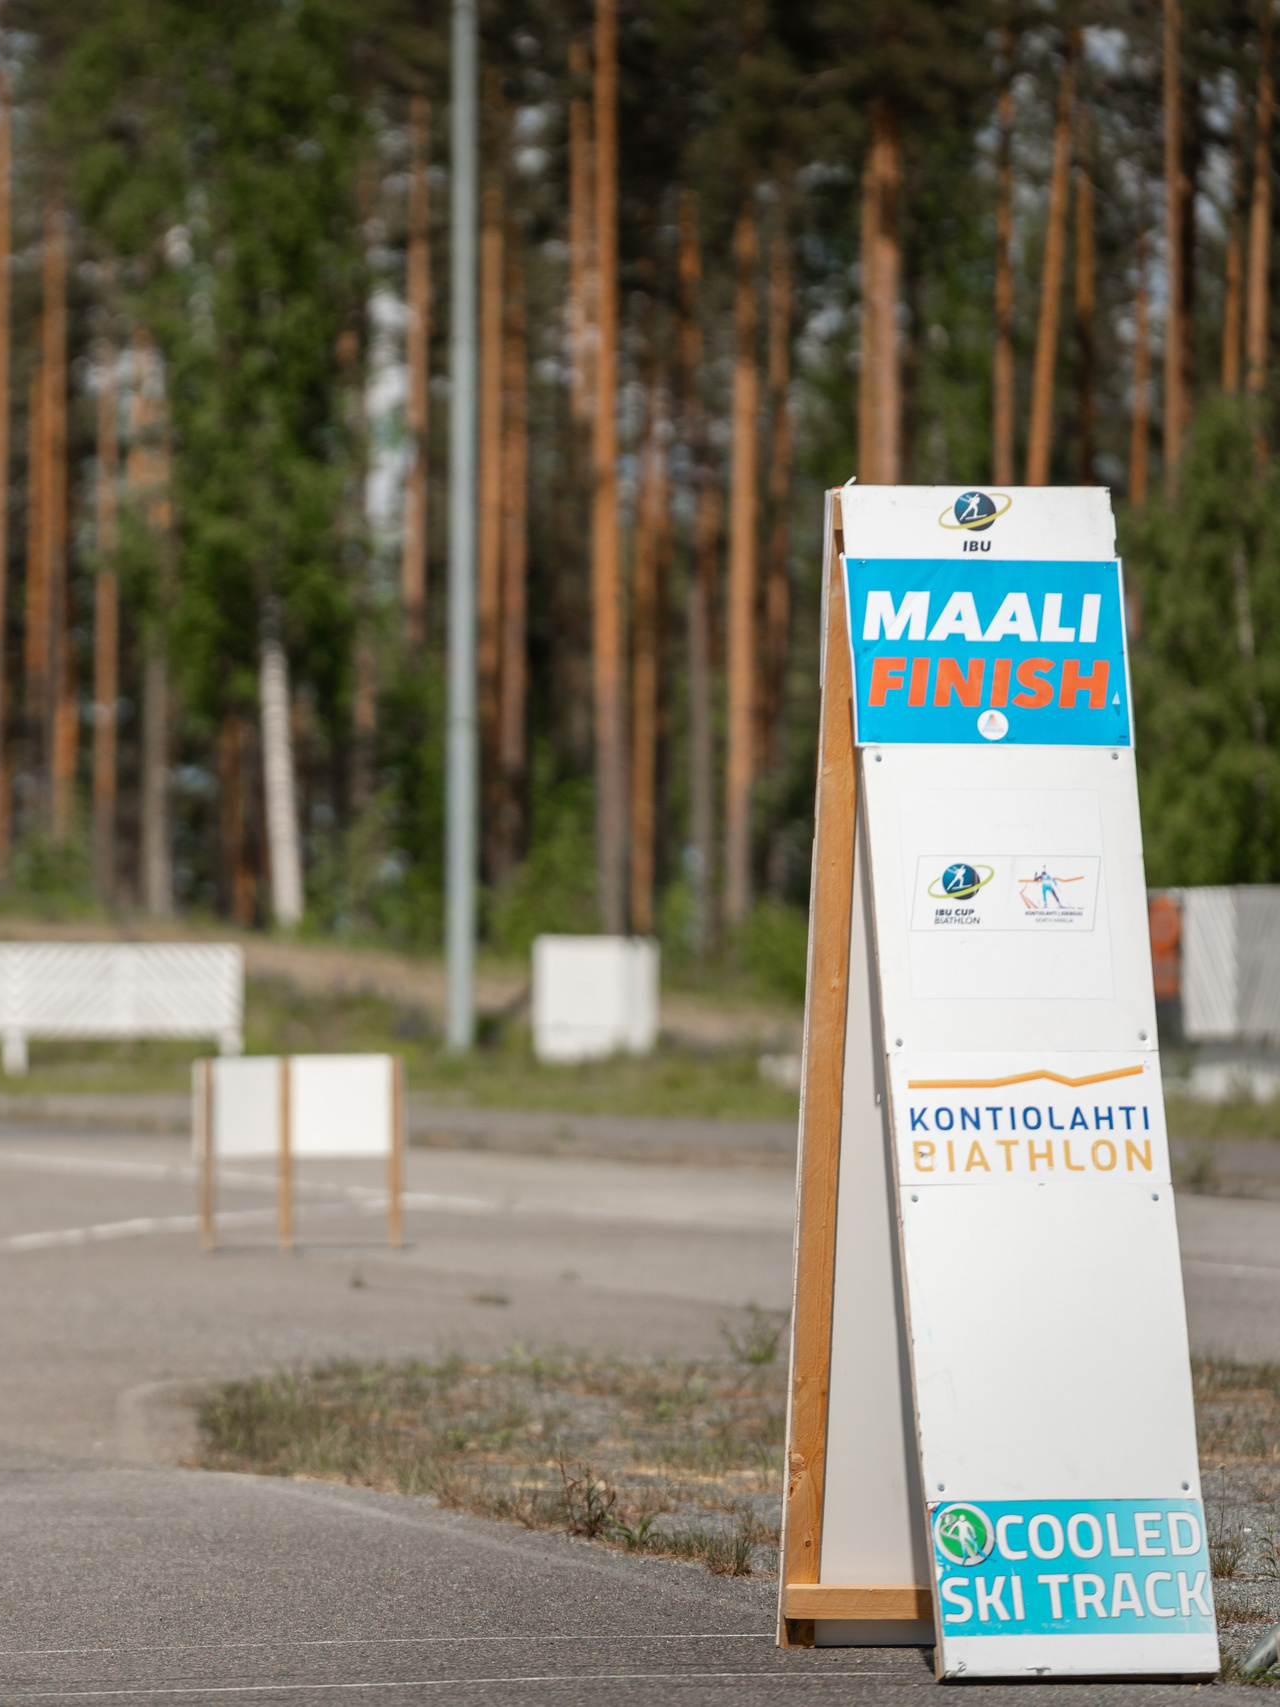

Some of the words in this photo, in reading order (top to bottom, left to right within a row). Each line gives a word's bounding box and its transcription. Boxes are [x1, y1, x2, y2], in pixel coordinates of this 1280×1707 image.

[962, 540, 992, 553] IBU
[862, 591, 1102, 643] MAALI
[868, 657, 1110, 709] FINISH
[934, 916, 980, 925] BIATHLON
[909, 1106, 1150, 1131] KONTIOLAHTI
[912, 1139, 1154, 1172] BIATHLON
[995, 1511, 1203, 1560] COOLED
[941, 1575, 1026, 1623] SKI
[1037, 1571, 1212, 1619] TRACK
